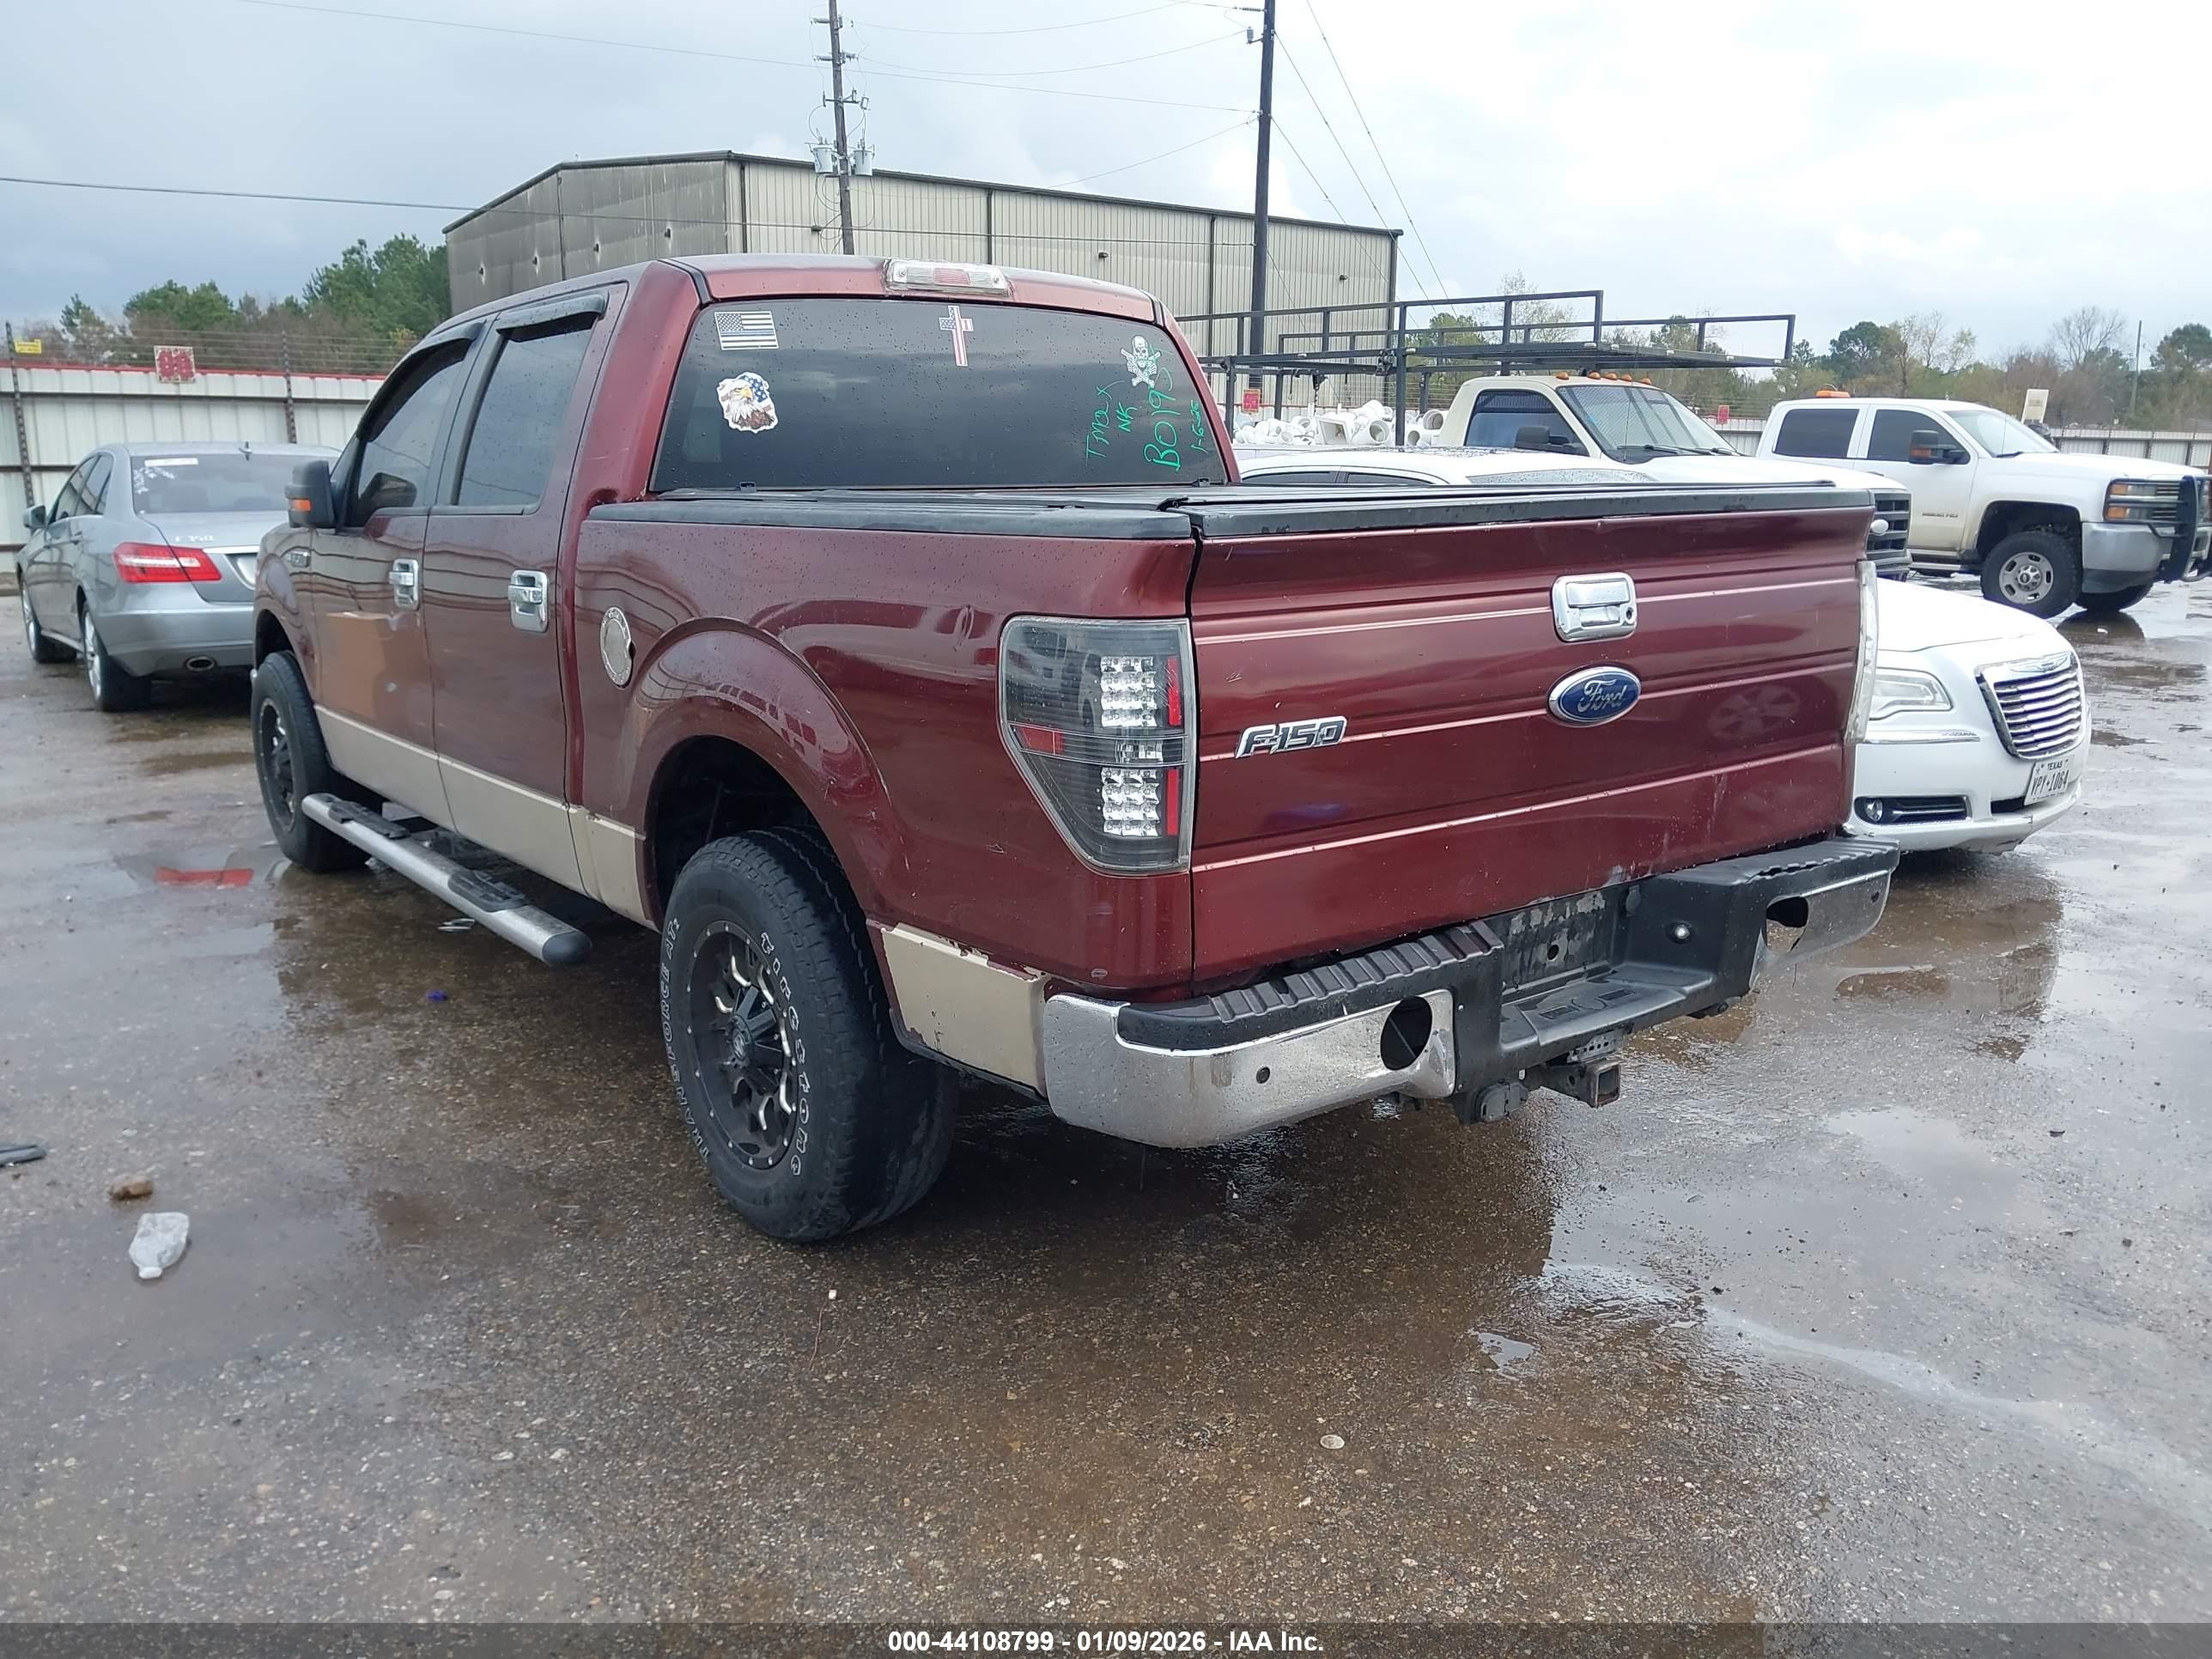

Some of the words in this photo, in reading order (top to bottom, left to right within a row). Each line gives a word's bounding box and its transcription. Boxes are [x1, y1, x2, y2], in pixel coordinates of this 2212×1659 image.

[1577, 678, 1628, 713] Ford
[1235, 715, 1347, 759] F-150
[2047, 761, 2063, 771] TEXAS
